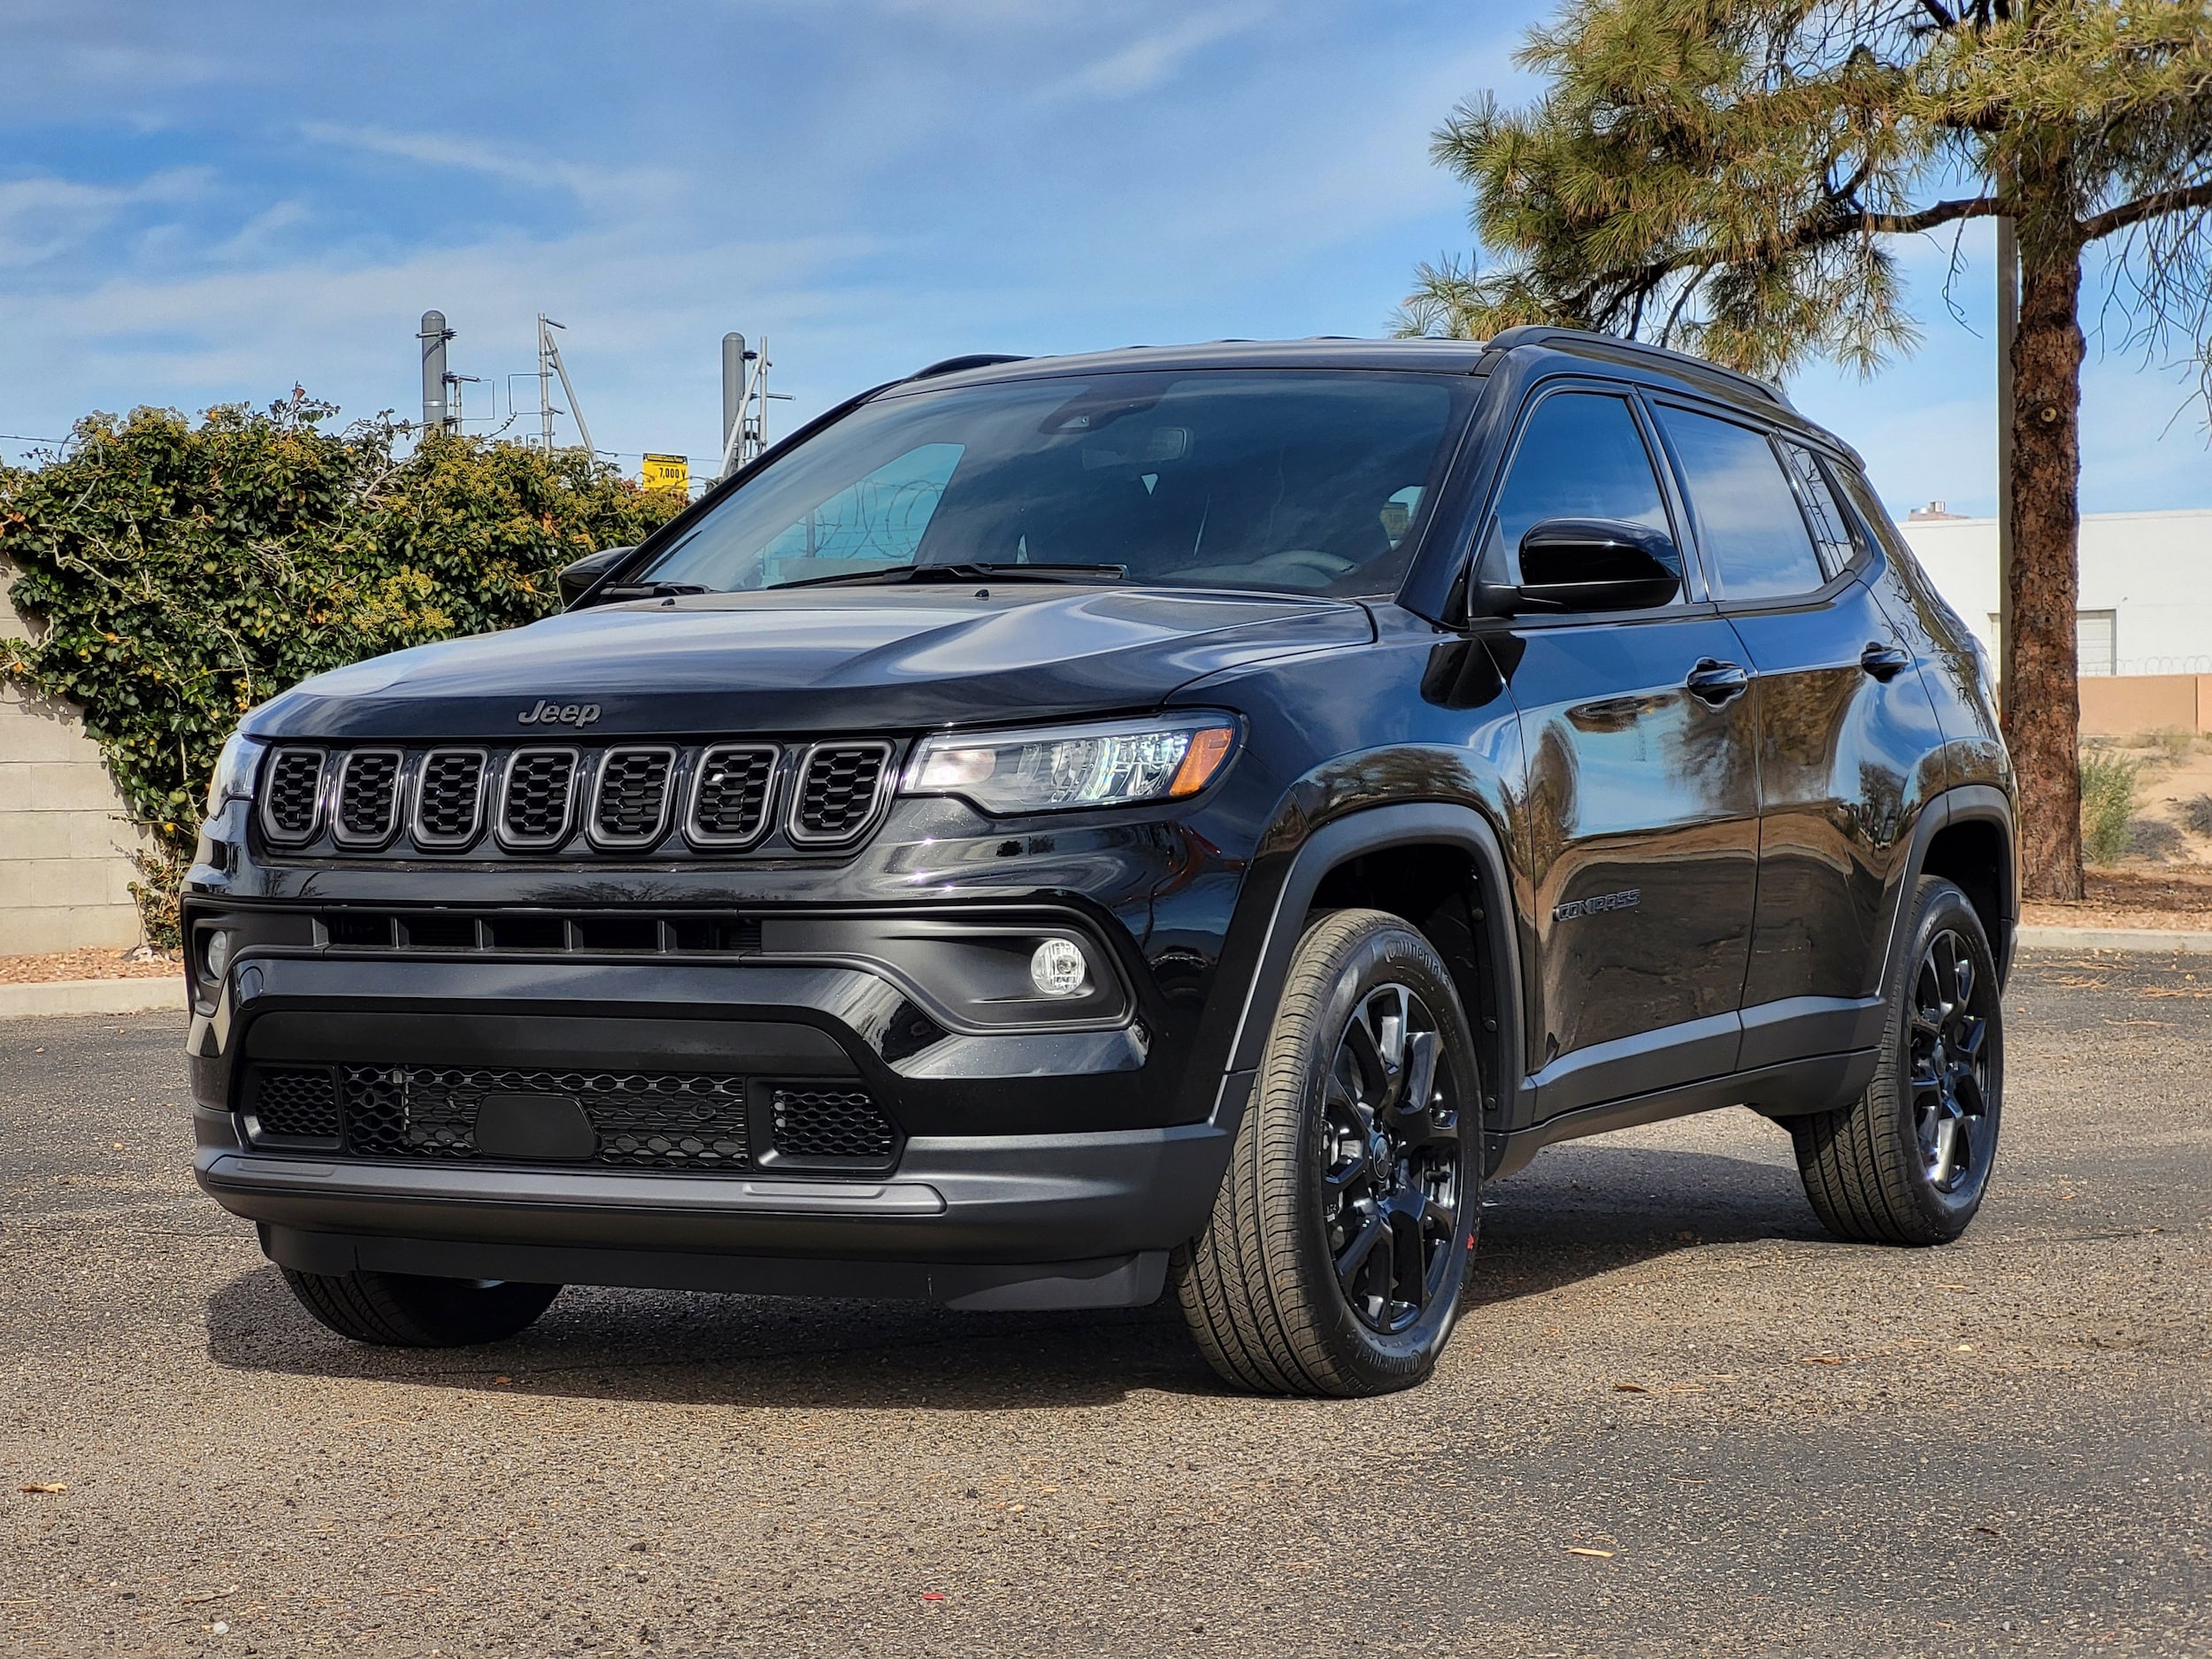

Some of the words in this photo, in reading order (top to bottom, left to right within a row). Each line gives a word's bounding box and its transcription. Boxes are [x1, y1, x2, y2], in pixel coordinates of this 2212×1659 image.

[659, 467, 680, 480] 7,000
[518, 699, 602, 727] Jeep
[1554, 888, 1640, 921] COMPASS
